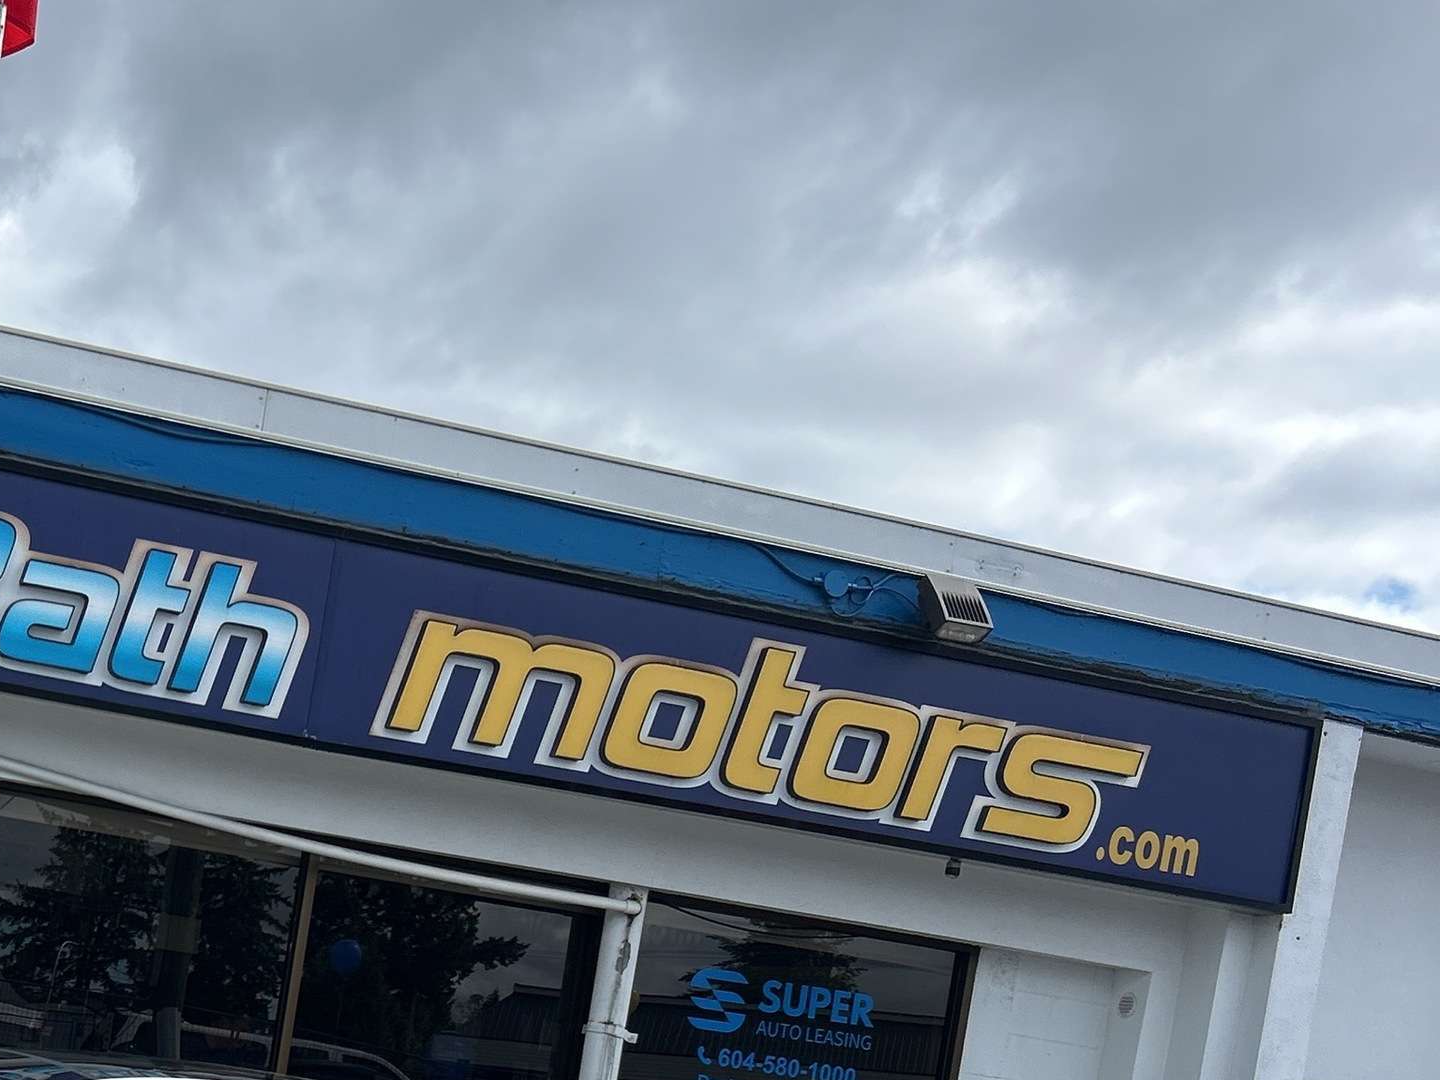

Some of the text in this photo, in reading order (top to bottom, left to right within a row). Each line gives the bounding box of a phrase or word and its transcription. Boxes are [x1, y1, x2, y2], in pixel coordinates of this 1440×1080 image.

[369, 610, 1150, 853] motors
[759, 979, 875, 1028] SUPER
[755, 1020, 873, 1051] AUTO LEASING
